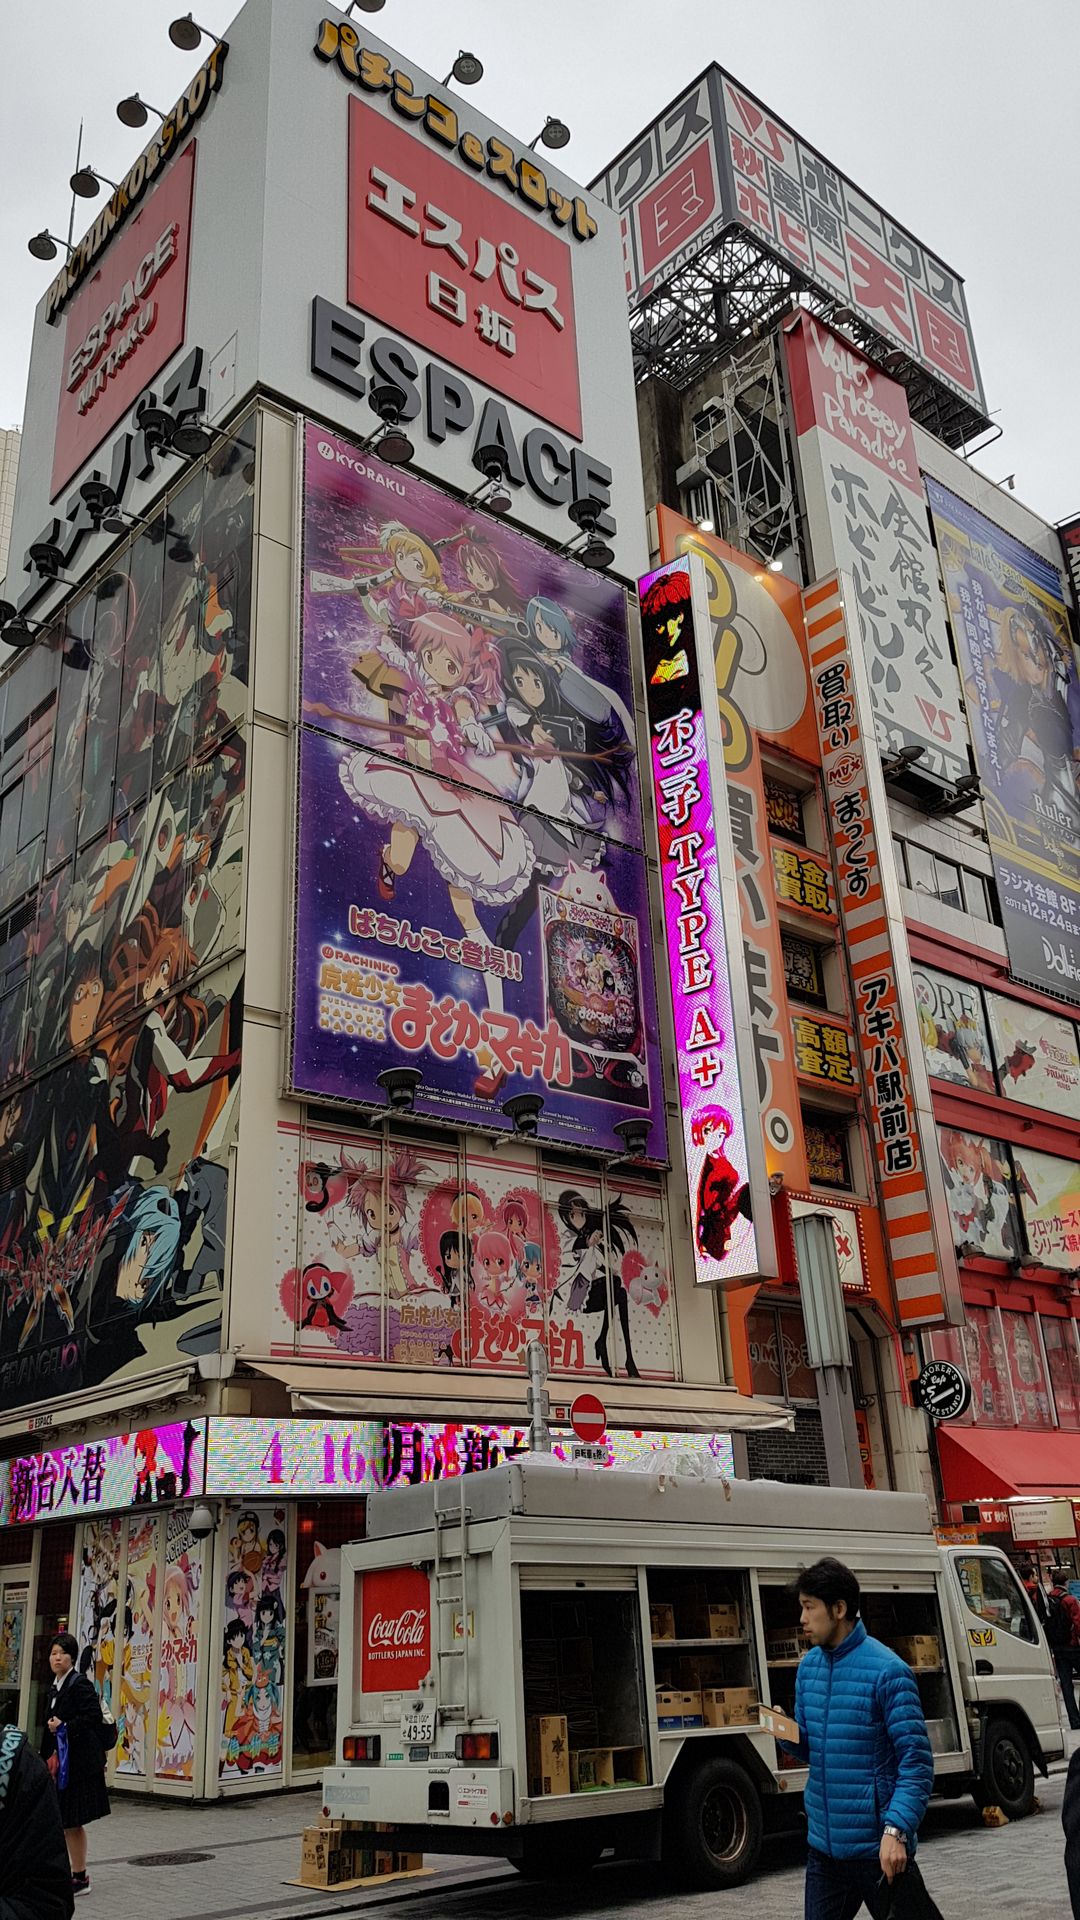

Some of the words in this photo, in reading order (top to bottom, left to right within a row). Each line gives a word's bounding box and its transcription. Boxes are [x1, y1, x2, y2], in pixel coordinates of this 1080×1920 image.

[730, 133, 840, 252] 秋葉原
[366, 165, 566, 331] エスパス
[736, 180, 846, 282] ホビー
[802, 154, 961, 316] ボークス
[66, 220, 180, 394] ESPACE
[428, 272, 516, 356] 日拓
[845, 230, 977, 392] 天国
[310, 294, 618, 539] ESPACE
[335, 451, 407, 498] KYORAKU
[1032, 793, 1073, 830] Ruler
[833, 793, 870, 896] まっくす
[774, 848, 828, 888] 現金
[999, 866, 1059, 911] ラジオ会館
[668, 831, 713, 993] TYPE
[778, 875, 831, 916] 買取
[334, 950, 400, 976] PACHINKO
[348, 903, 523, 982] ぱちんこで登場!!
[319, 1017, 386, 1041] MAGICA
[320, 1004, 386, 1028] MADOKA
[795, 1019, 848, 1057] 高額
[798, 1048, 853, 1086] 査定
[860, 976, 914, 1171] アキバ駅前店
[1034, 1233, 1080, 1256] シリーズ続
[920, 1364, 958, 1386] SMOKER'S
[34, 1414, 53, 1430] ESPACE
[368, 1609, 427, 1648] Coca-Cola
[368, 1650, 393, 1661] BOTTLERS
[393, 1649, 414, 1659] JAPAN
[407, 1724, 432, 1741] 49-55
